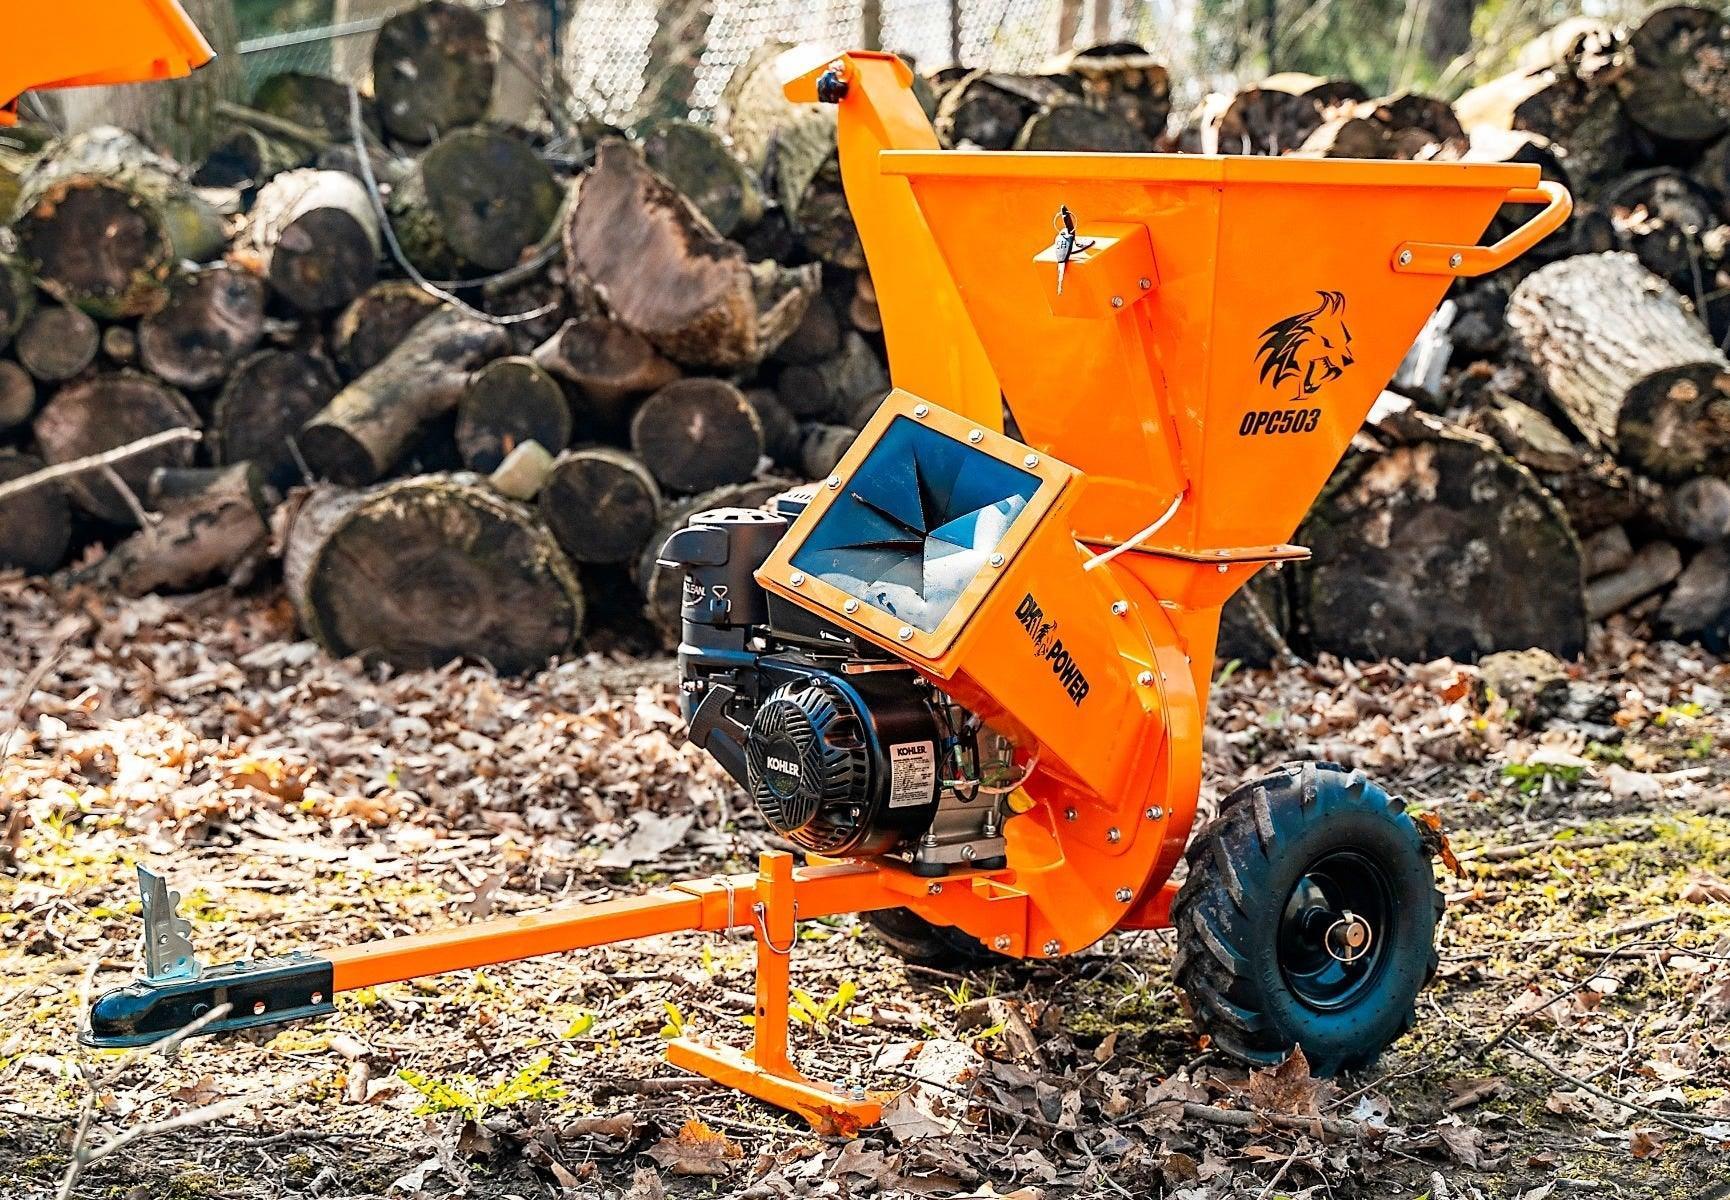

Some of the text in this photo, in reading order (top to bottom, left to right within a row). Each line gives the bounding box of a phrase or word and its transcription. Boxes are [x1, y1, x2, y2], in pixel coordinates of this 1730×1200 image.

[1239, 409, 1322, 436] OPC503
[1045, 639, 1090, 708] POWER
[896, 745, 927, 756] KOHLER
[767, 756, 801, 777] KOHLER
